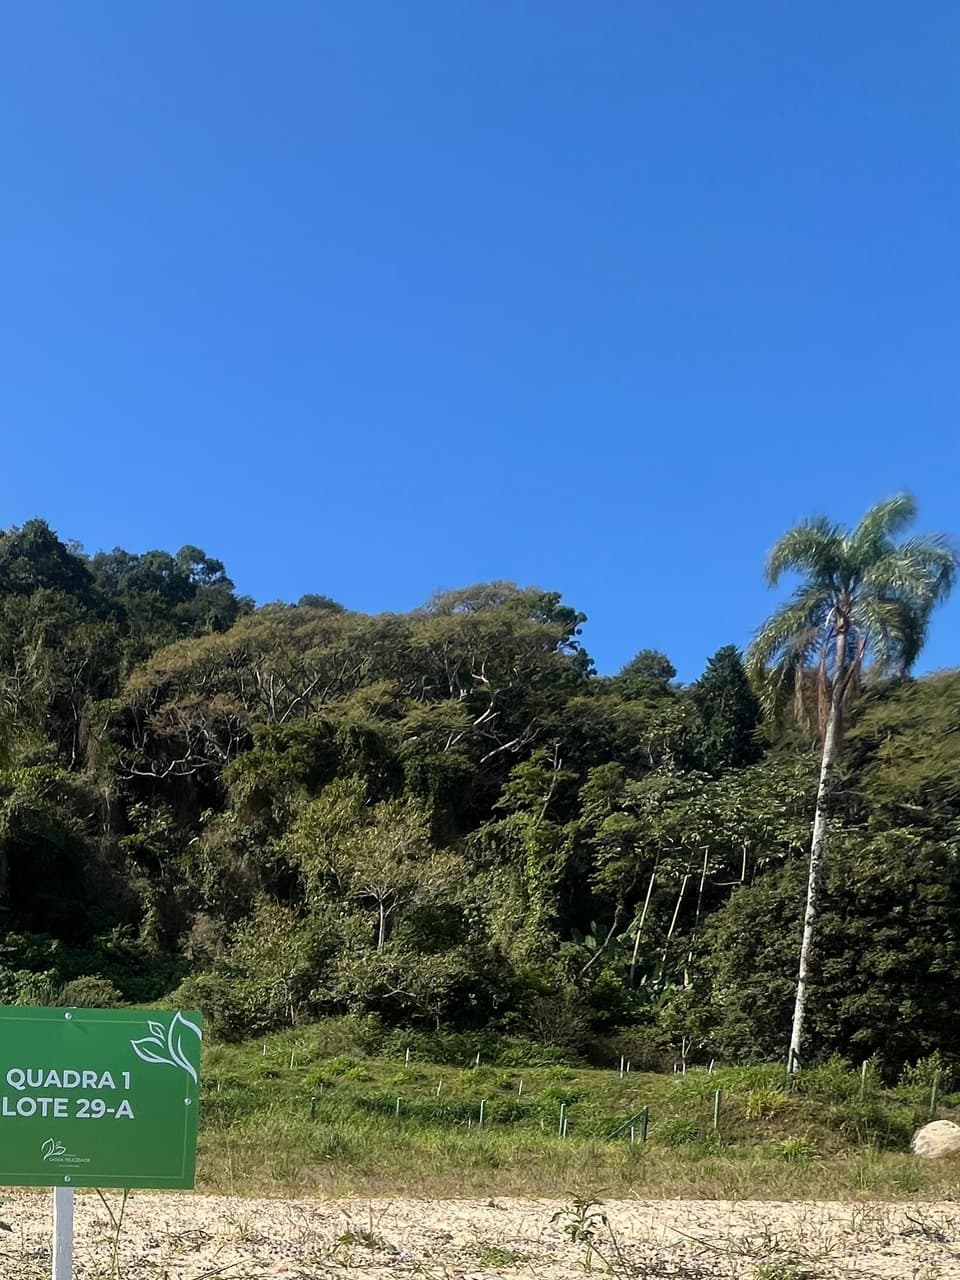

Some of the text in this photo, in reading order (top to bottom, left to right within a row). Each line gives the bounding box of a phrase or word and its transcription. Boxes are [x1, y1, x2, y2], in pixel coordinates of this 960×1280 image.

[6, 1068, 131, 1090] QUADRA 1
[2, 1096, 135, 1119] LOTE 29-A
